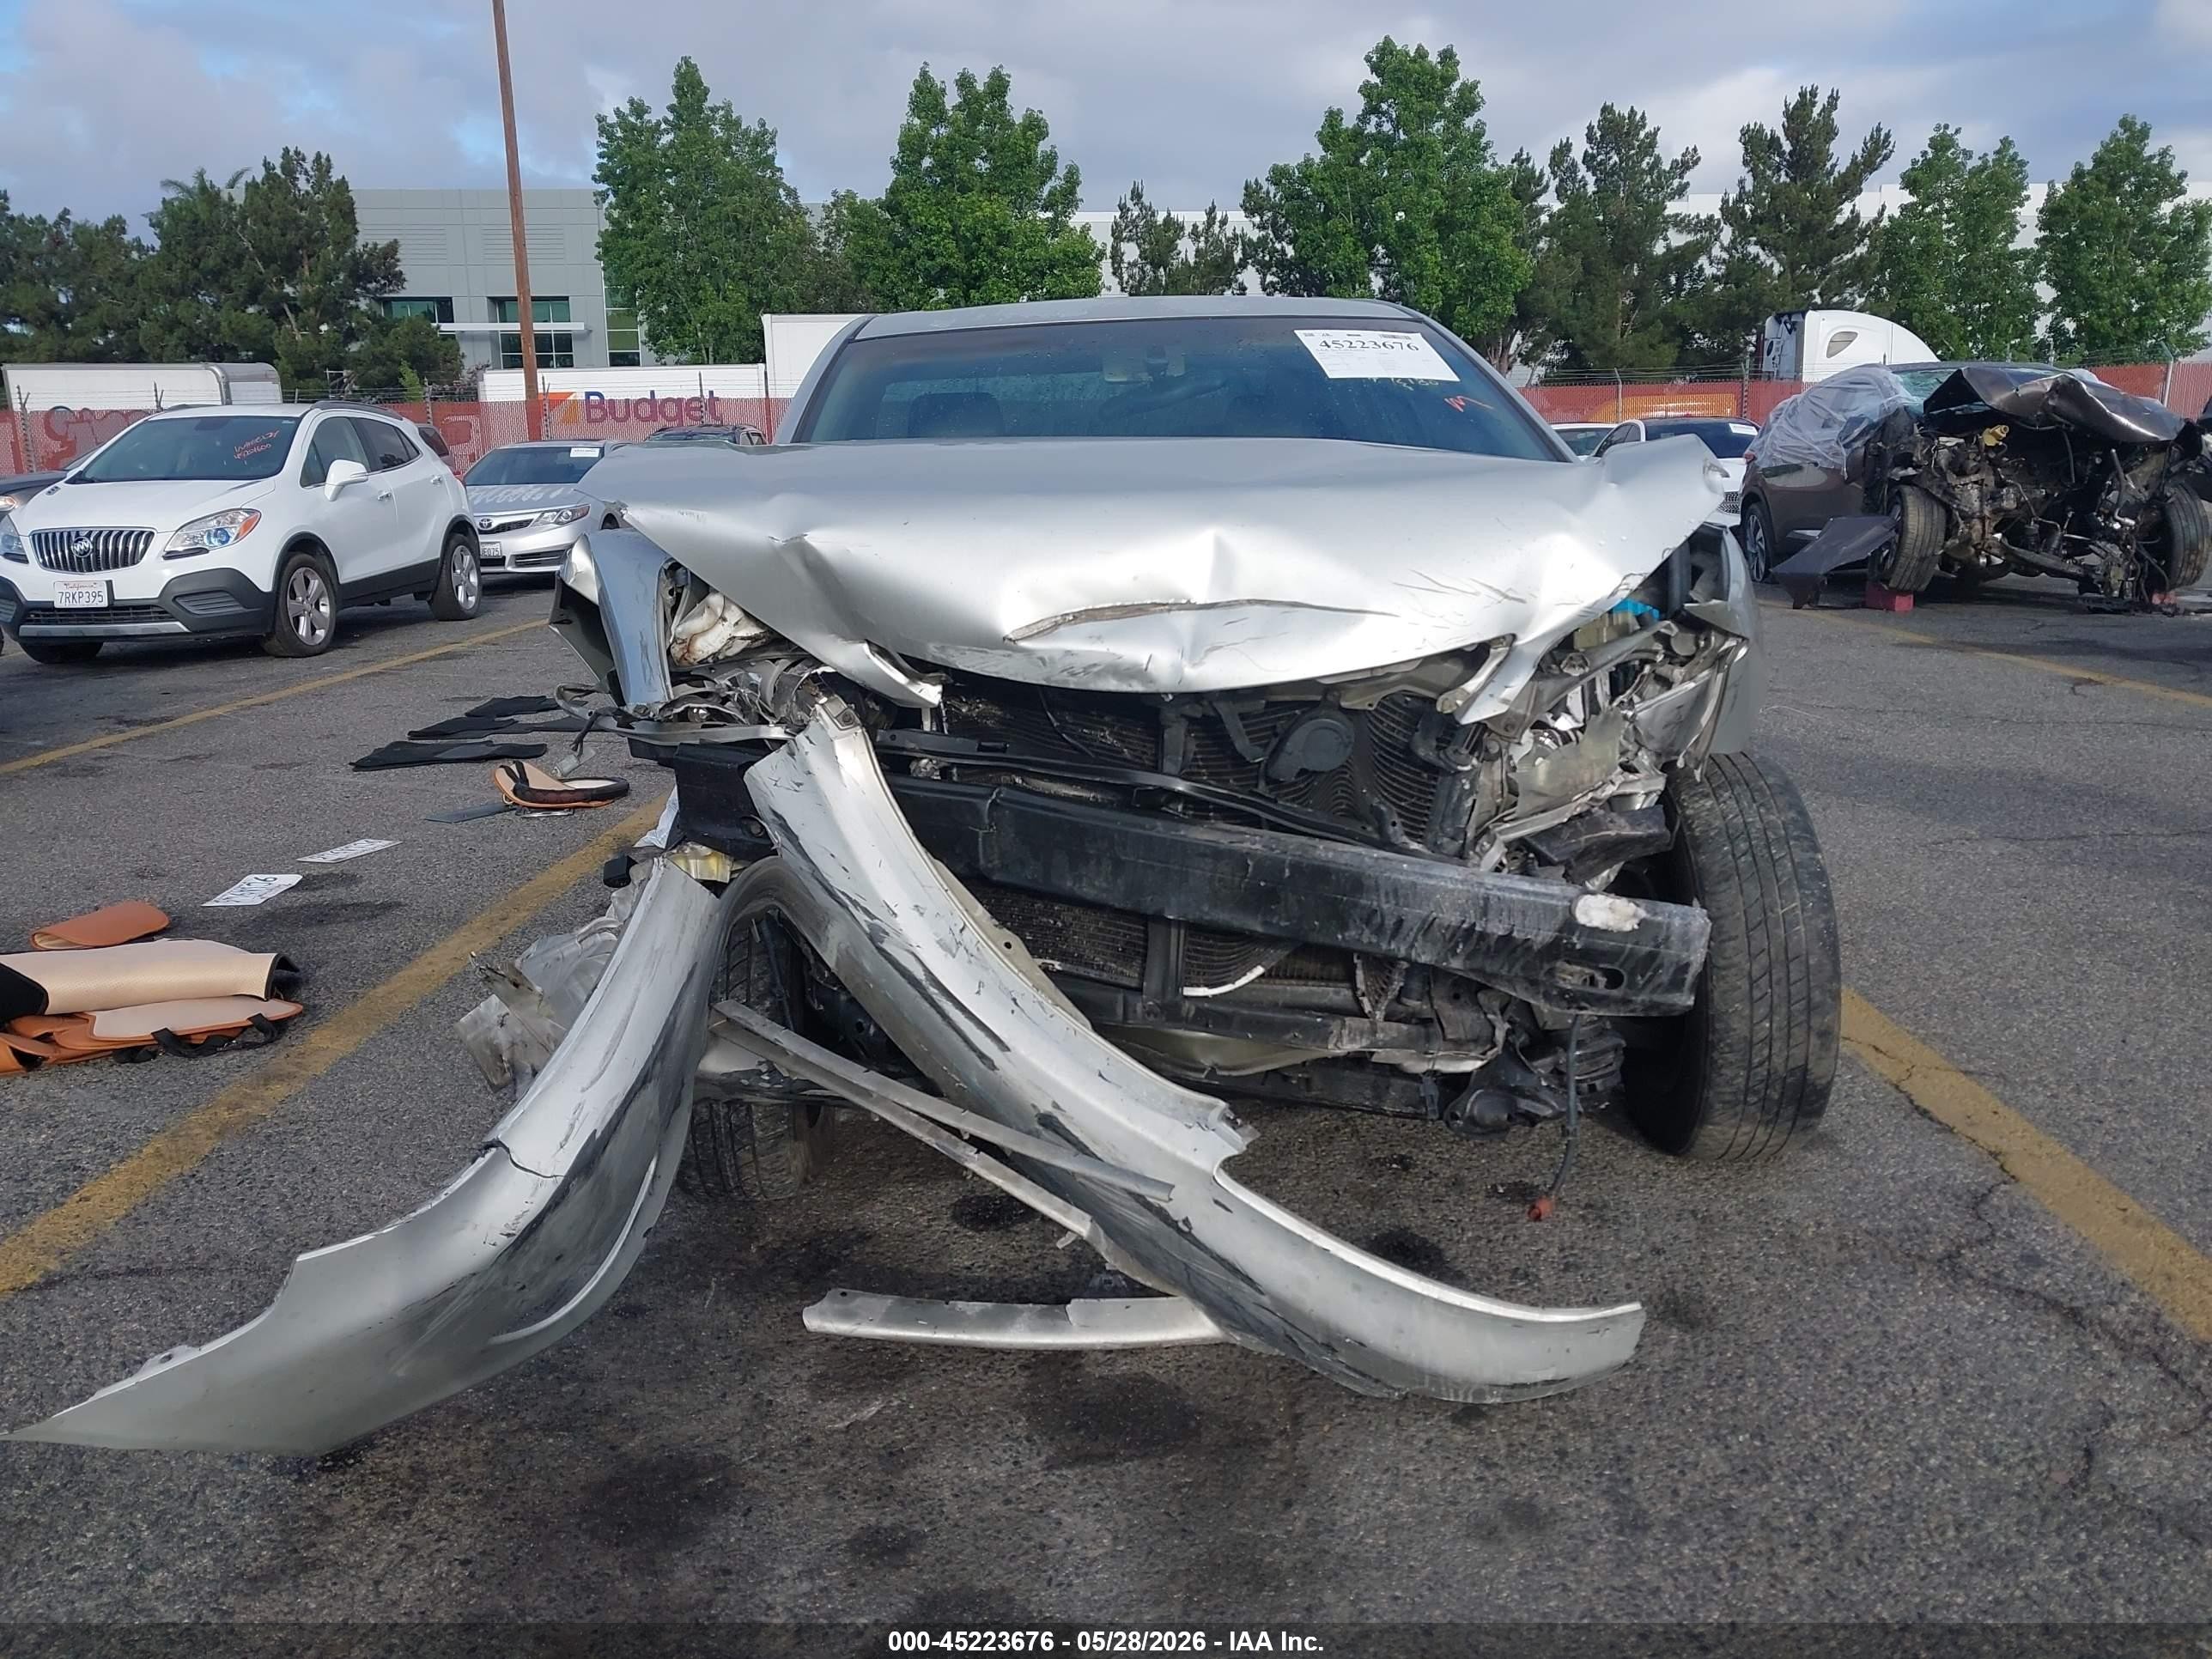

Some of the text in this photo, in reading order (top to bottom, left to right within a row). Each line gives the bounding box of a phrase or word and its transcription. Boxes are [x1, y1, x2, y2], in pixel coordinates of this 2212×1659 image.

[1319, 339, 1419, 351] 45223676
[585, 390, 721, 426] Budget
[58, 591, 104, 605] 7RKP395
